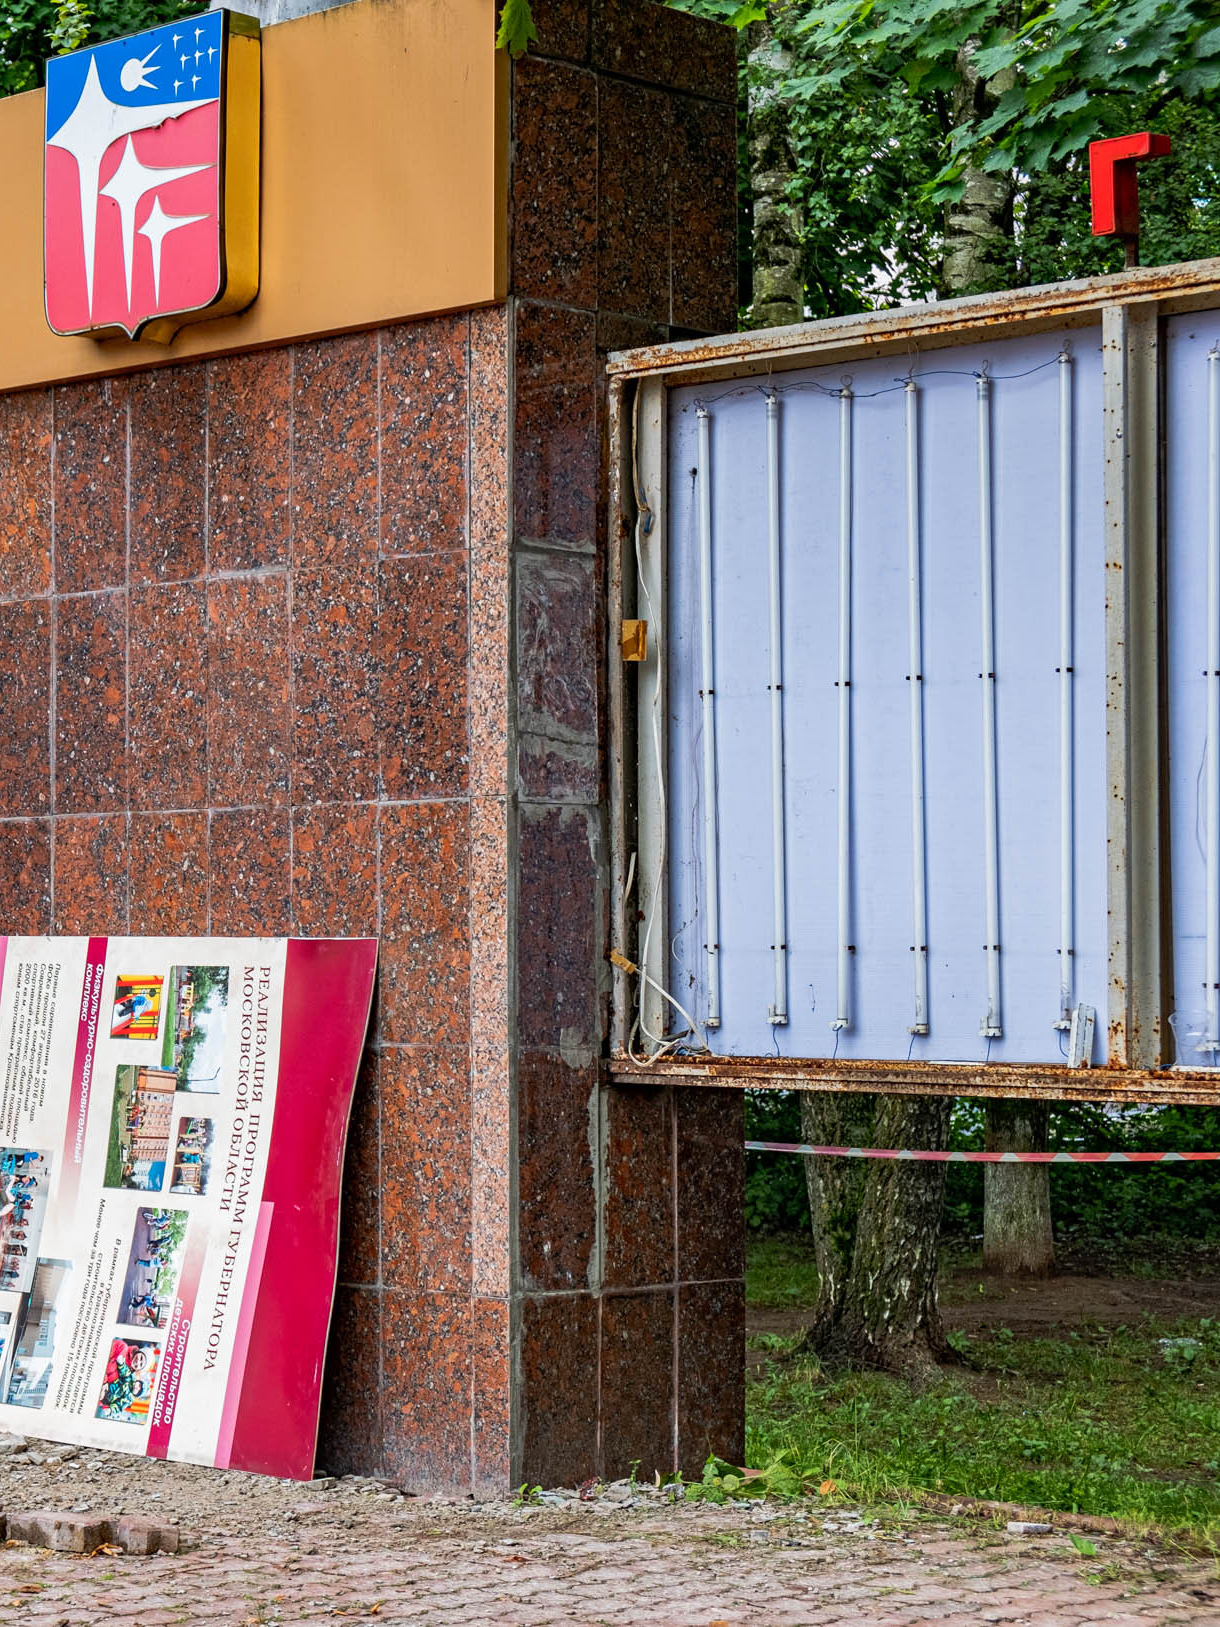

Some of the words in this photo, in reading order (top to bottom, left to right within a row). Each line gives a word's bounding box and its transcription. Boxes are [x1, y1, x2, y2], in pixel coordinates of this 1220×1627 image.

[28, 963, 38, 1015] спортивный
[51, 964, 61, 998] Первые
[80, 963, 95, 1021] комплекс
[9, 991, 20, 1049] спортсменам
[41, 992, 49, 1026] прошли
[43, 1002, 55, 1066] соревнования
[252, 966, 271, 1102] РЕАЛИЗАЦИЯ
[11, 1037, 22, 1091] прекрасным
[35, 1043, 44, 1074] апреля
[74, 963, 105, 1163] Физкультурно-оздоровительный
[235, 966, 255, 1110] МОСКОВСКОЙ
[18, 1066, 27, 1095] общей
[24, 1030, 38, 1111] комфортабельный
[38, 1078, 46, 1107] новом
[5, 1094, 15, 1137] подарком
[11, 1097, 22, 1144] площадью
[220, 1117, 244, 1211] ОБЛАСТИ
[232, 1113, 260, 1224] ПРОГРАММ
[95, 1198, 106, 1228] Менее
[82, 1278, 90, 1299] года
[85, 1252, 103, 1322] строительство
[86, 1262, 94, 1278] три
[108, 1247, 119, 1281] рамках
[70, 1302, 85, 1349] построено
[91, 1283, 112, 1359] губернаторской
[167, 1298, 184, 1354] детских
[203, 1230, 241, 1371] ГУБЕРНАТОРА
[75, 1323, 88, 1360] детских
[79, 1290, 104, 1374] Краснознаменске
[77, 1360, 94, 1415] программы
[152, 1356, 172, 1427] площадок
[163, 1319, 191, 1424] Строительство
